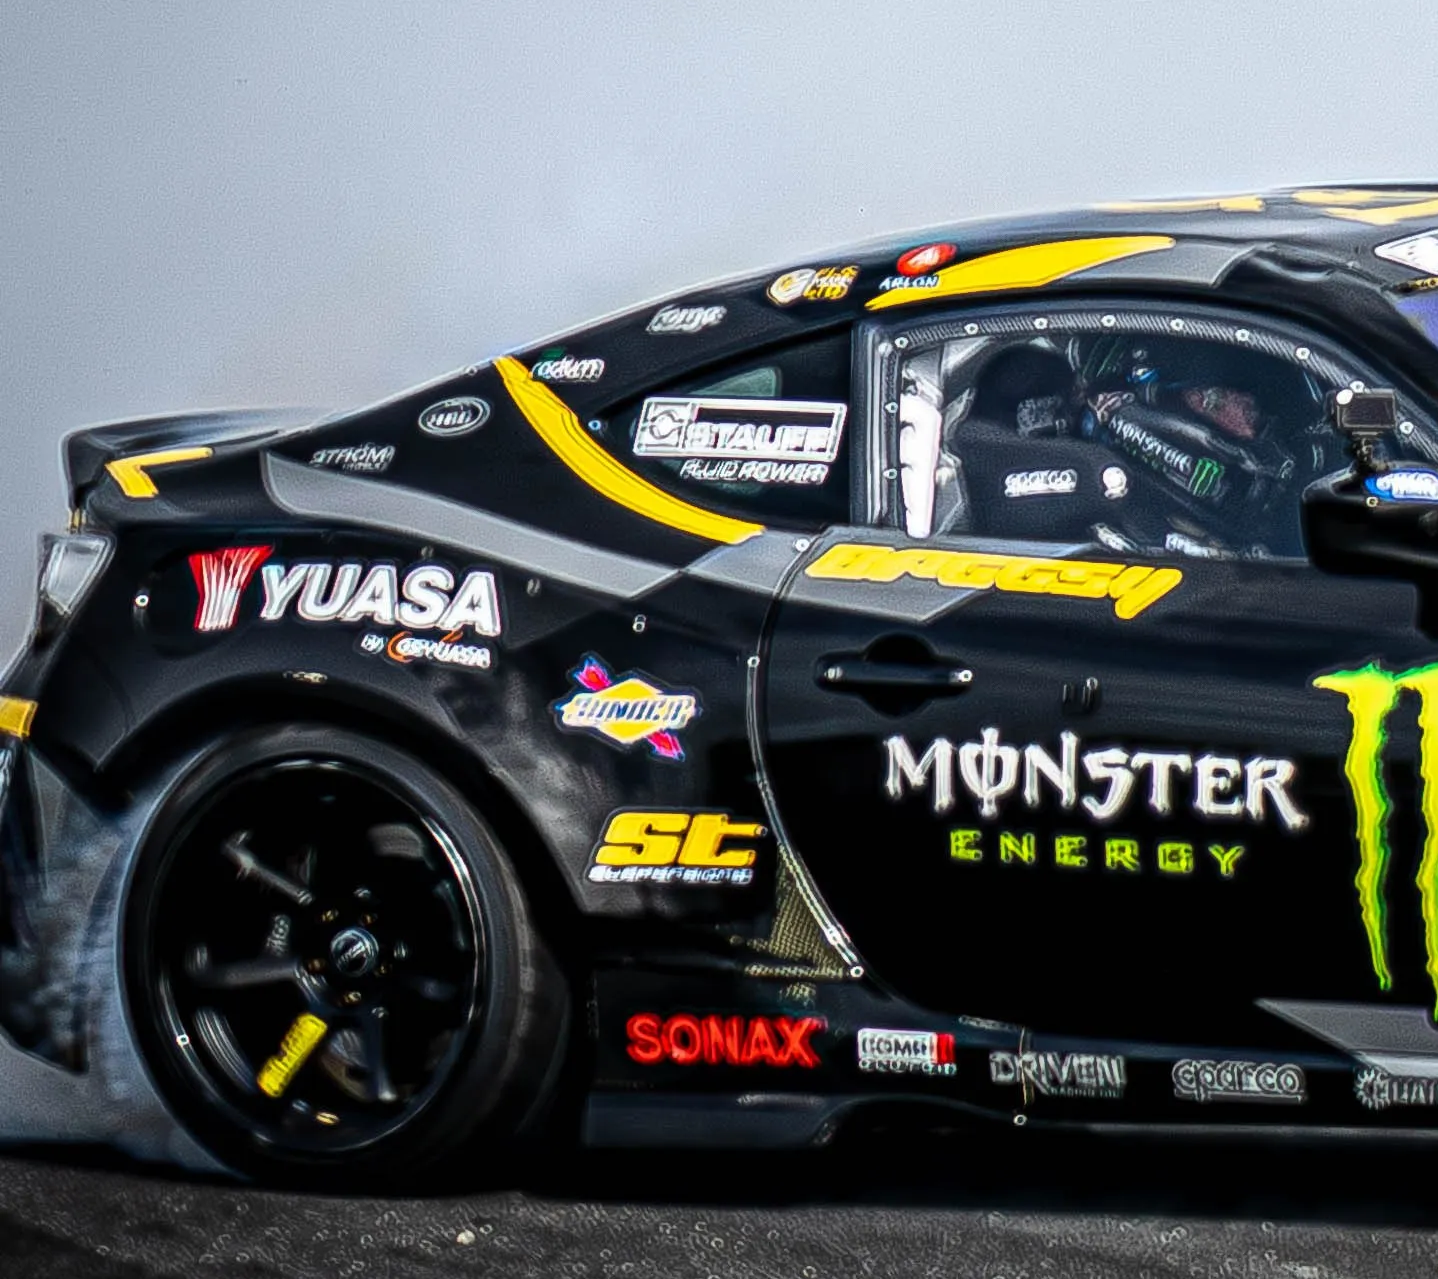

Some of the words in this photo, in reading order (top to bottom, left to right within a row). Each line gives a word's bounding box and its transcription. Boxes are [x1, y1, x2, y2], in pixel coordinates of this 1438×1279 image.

[686, 423, 832, 453] STAUFF
[680, 459, 739, 481] FLUID
[740, 462, 829, 484] POWER
[260, 563, 501, 636] YUASA
[884, 727, 1308, 829] MONSTER
[949, 829, 1245, 877] ENERGY
[626, 1012, 823, 1067] SONAX
